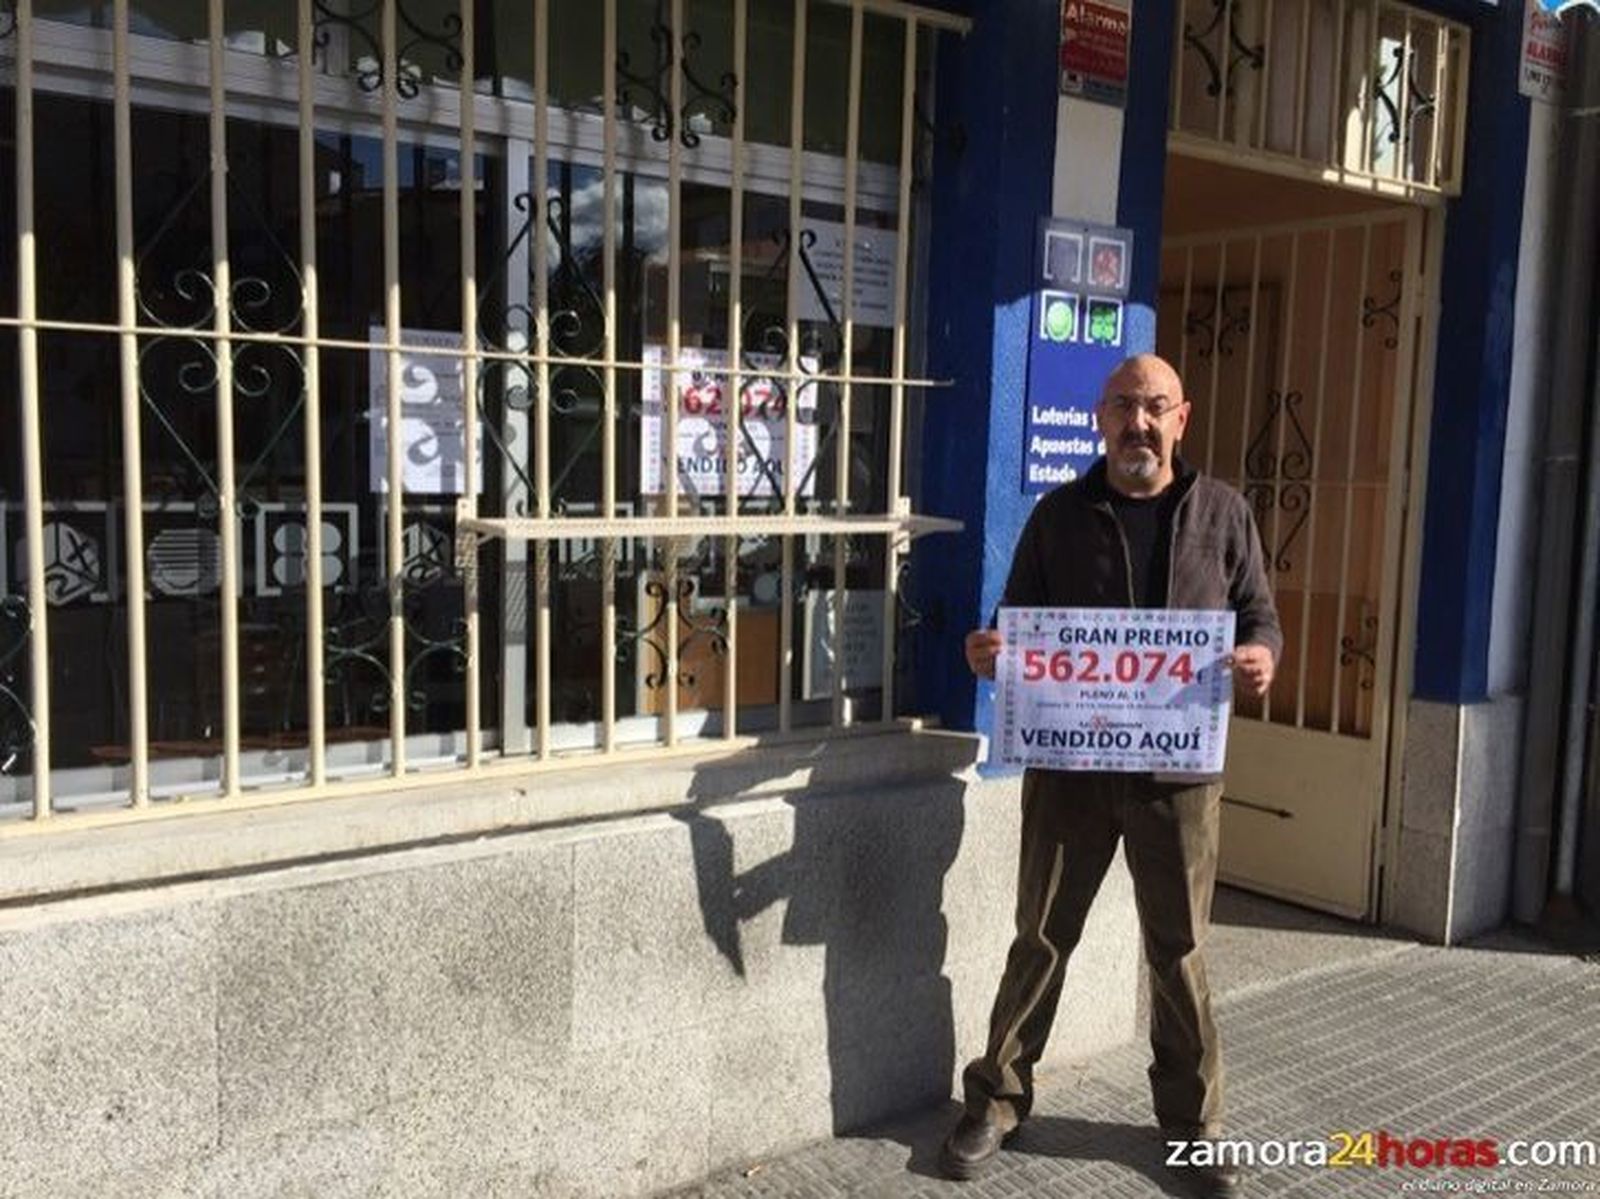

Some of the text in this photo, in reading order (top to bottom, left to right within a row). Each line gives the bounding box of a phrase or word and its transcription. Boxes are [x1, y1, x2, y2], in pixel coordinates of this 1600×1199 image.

[1032, 405, 1088, 426] Loterías
[1030, 435, 1093, 458] Apuestas
[1029, 464, 1077, 482] Estado
[1058, 627, 1117, 645] GRAN
[1124, 628, 1210, 647] PREMIO
[1022, 650, 1194, 684] 562.074
[1020, 726, 1201, 753] VENDIDO AQUÍ
